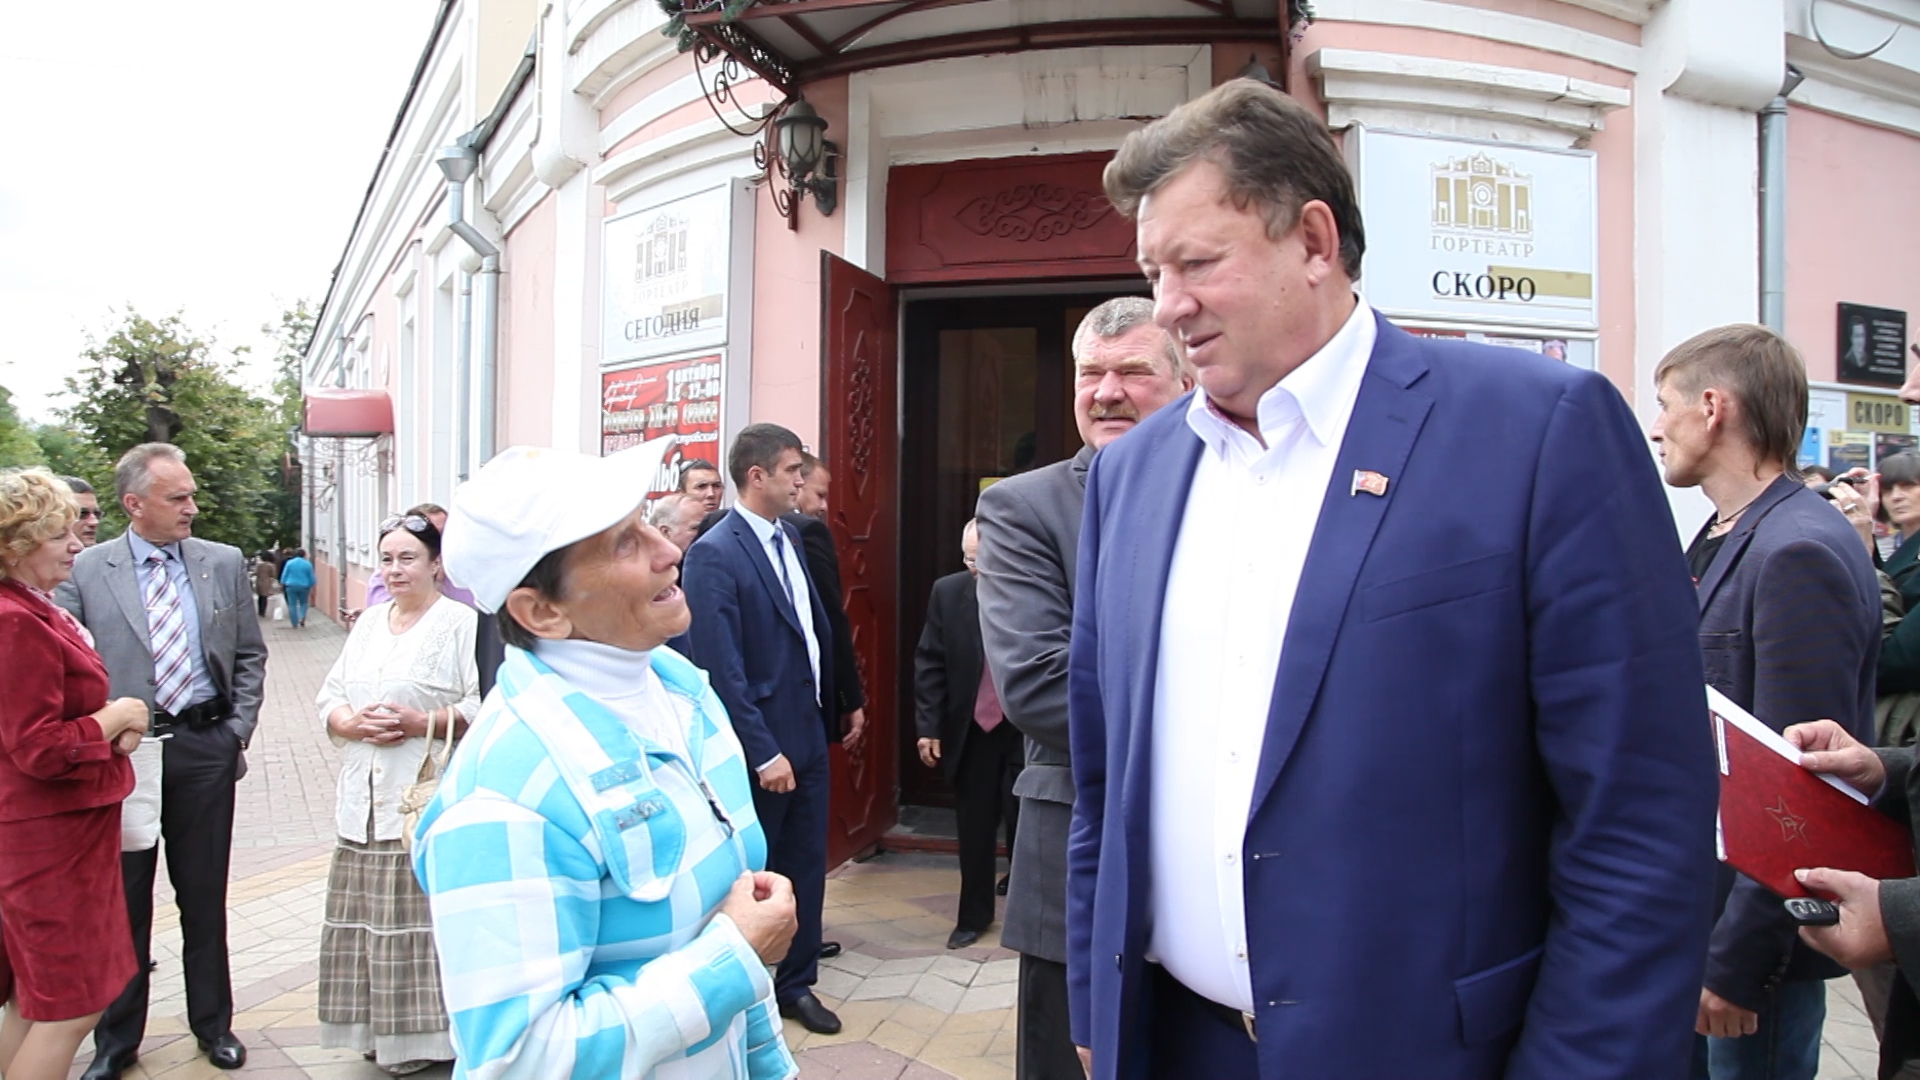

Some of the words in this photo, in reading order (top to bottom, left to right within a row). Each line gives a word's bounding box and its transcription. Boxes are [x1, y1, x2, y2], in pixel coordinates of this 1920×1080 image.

[1431, 235, 1534, 257] ГОРТЕАТР
[1432, 270, 1537, 302] СКОРО
[624, 307, 700, 342] СЕГОДНЯ
[1855, 401, 1903, 426] СКОРО
